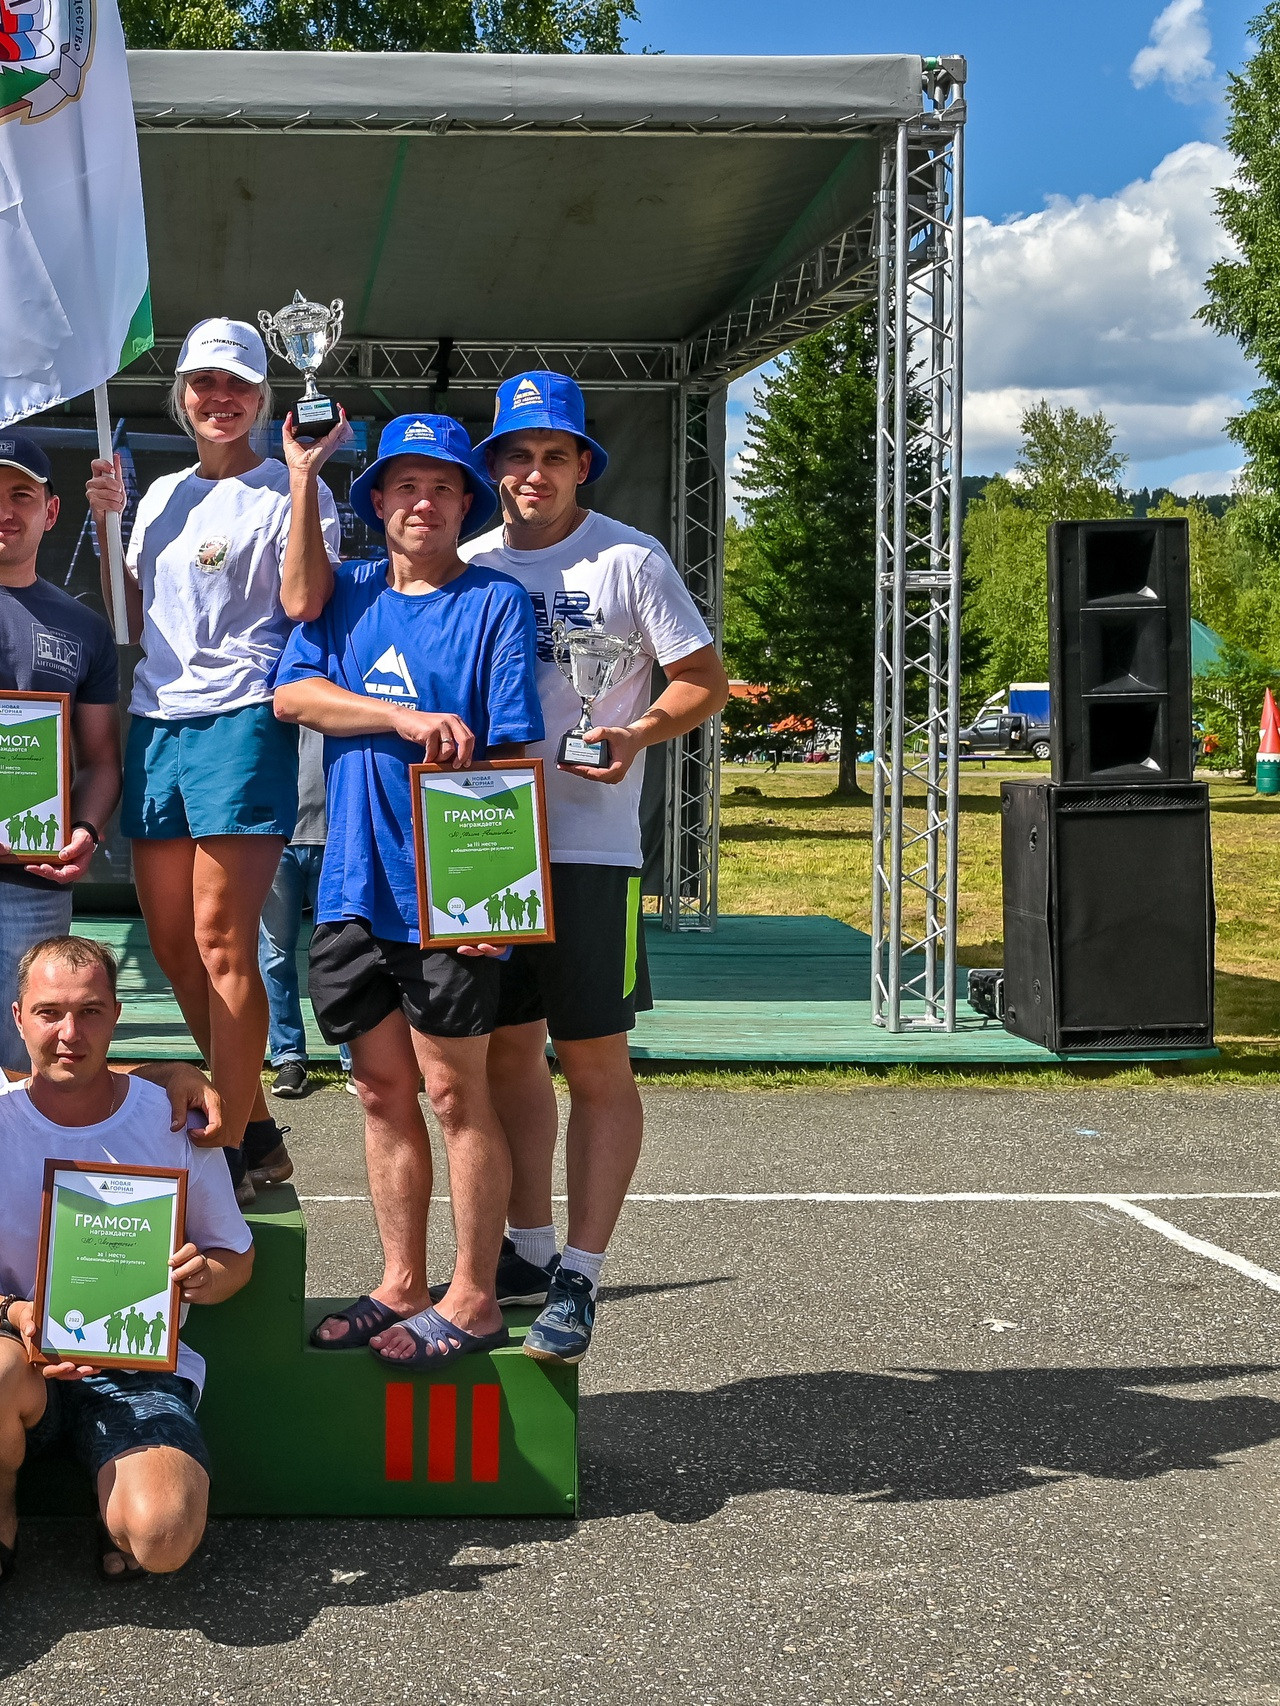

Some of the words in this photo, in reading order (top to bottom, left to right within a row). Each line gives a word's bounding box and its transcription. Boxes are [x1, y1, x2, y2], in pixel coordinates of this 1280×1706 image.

[444, 808, 515, 822] ГРАМОТА
[75, 1214, 151, 1232] ГРАМОТА
[90, 1229, 136, 1237] награждается
